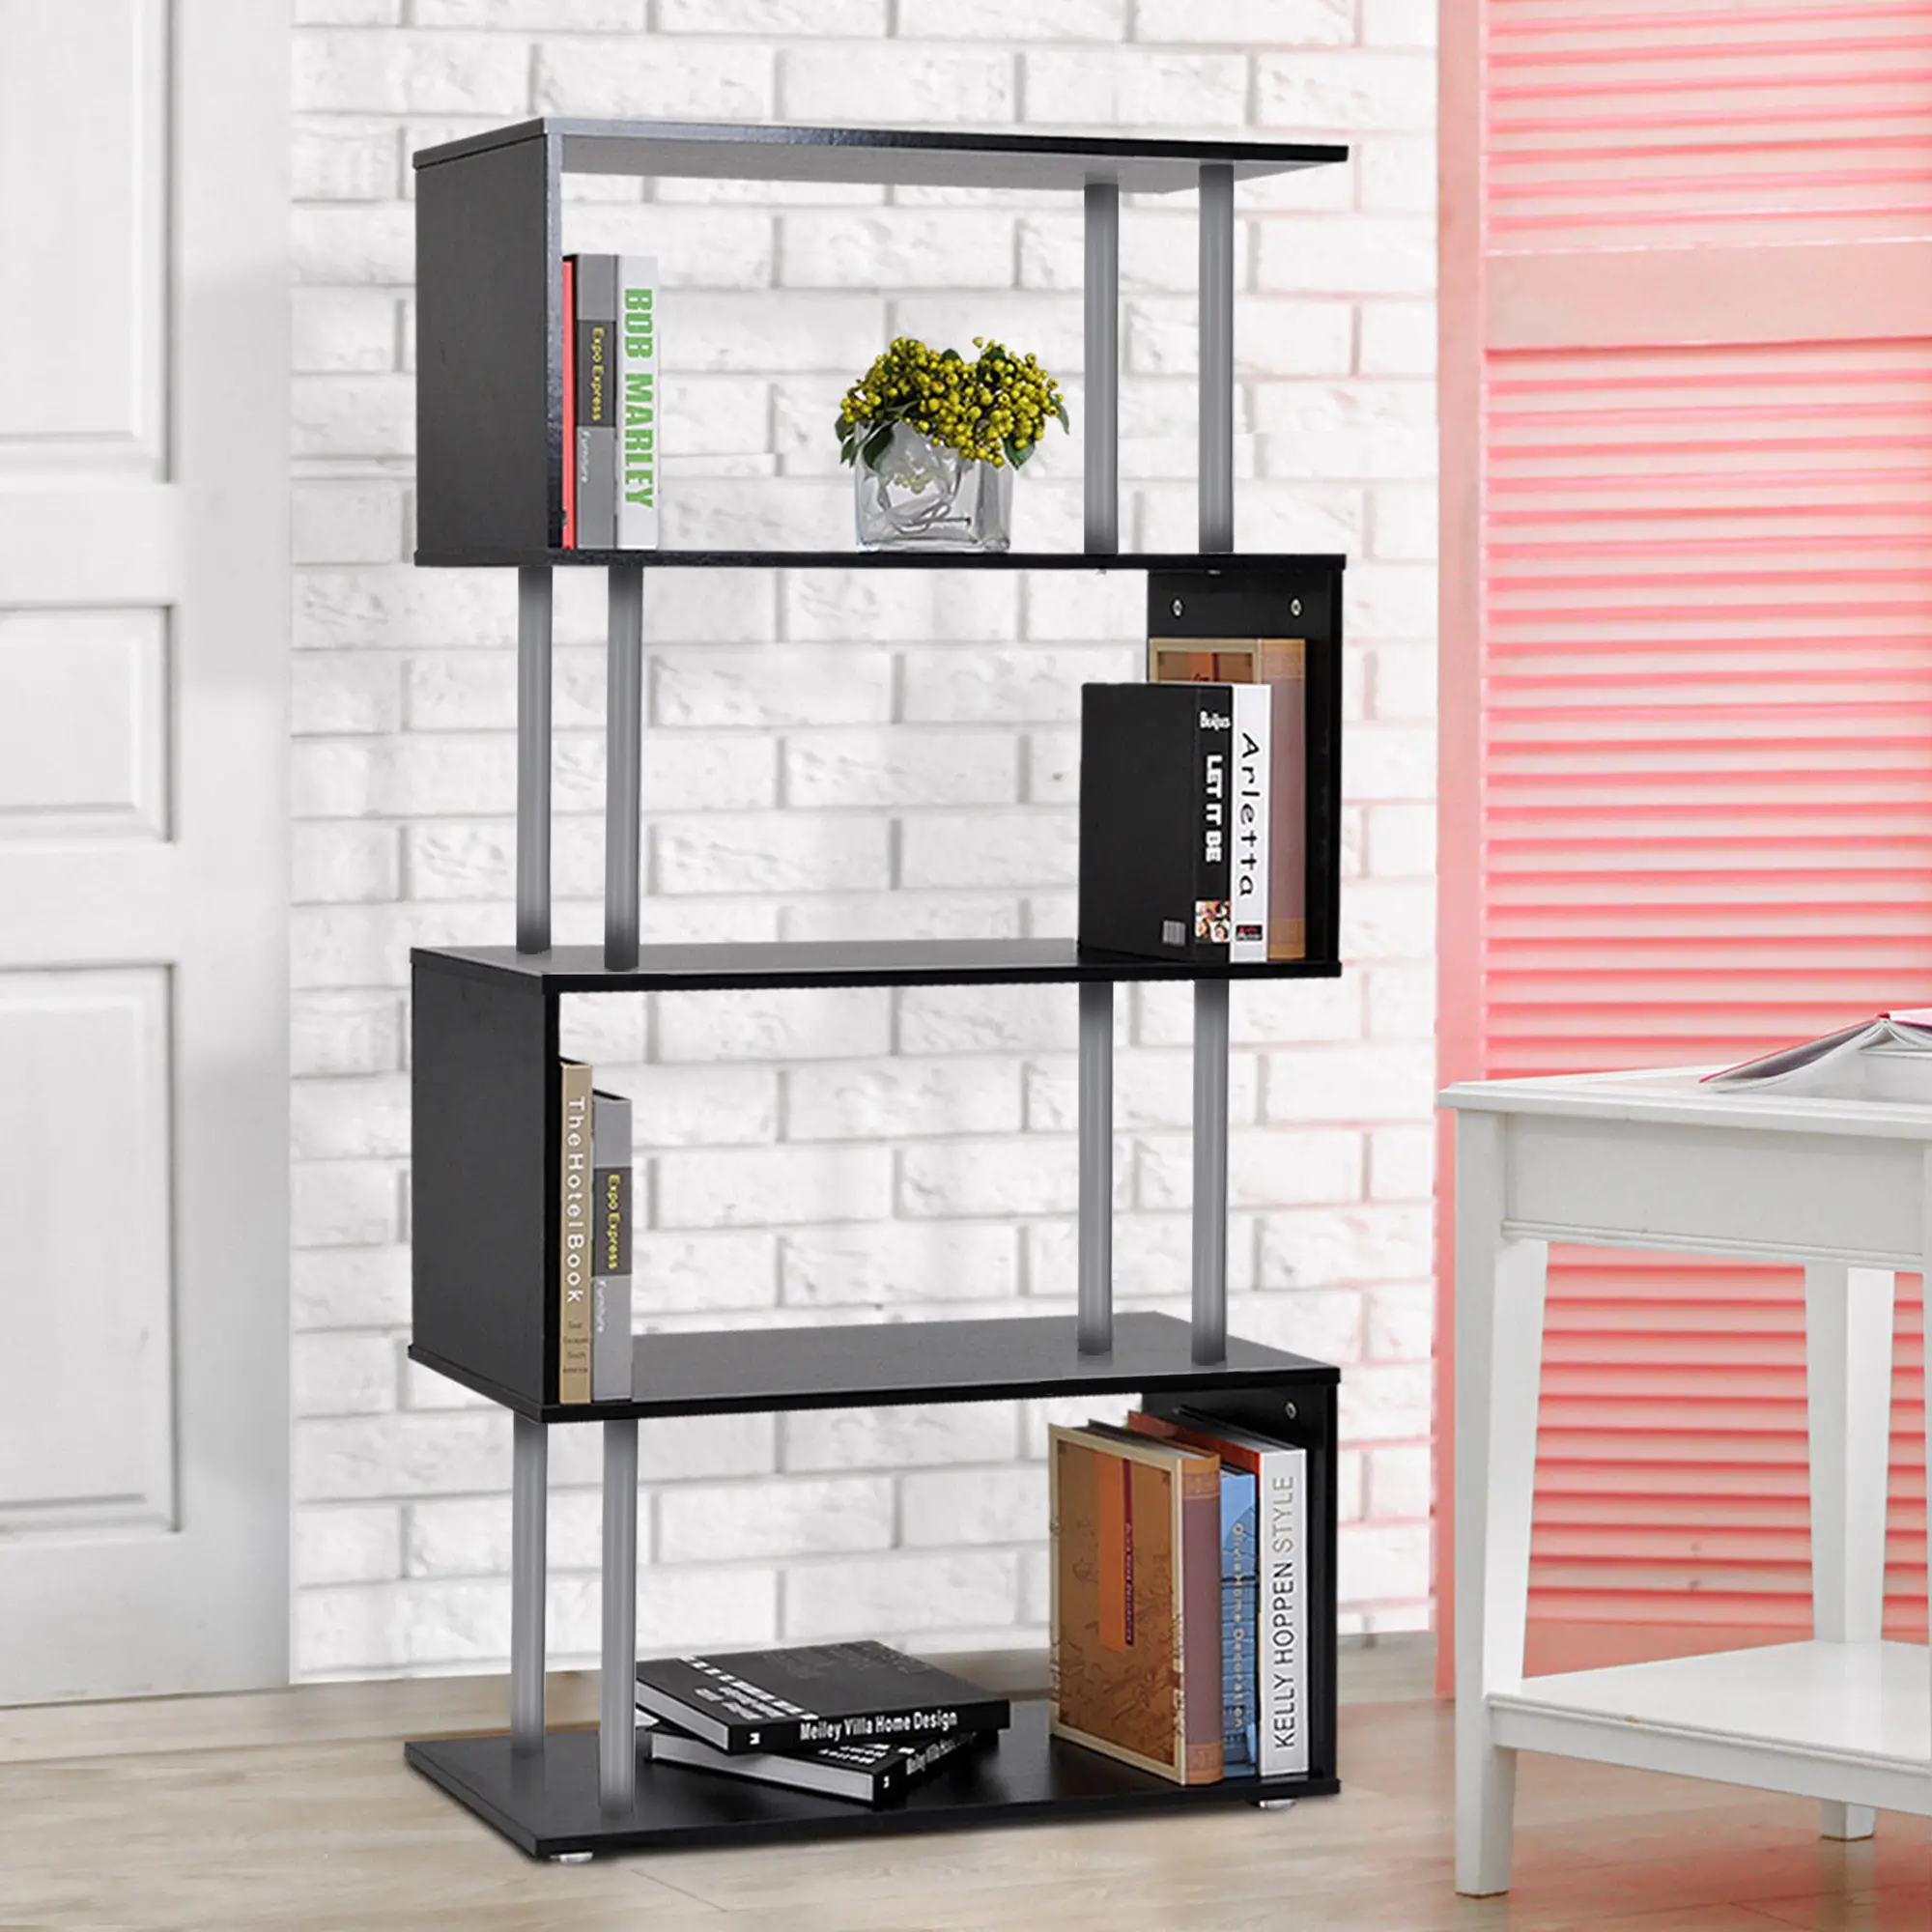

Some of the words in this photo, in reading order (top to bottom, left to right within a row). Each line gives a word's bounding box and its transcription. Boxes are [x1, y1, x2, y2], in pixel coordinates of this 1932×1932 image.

[590, 327, 605, 362] Expo
[625, 289, 654, 357] BOB
[590, 365, 605, 422] Express
[625, 374, 654, 508] MARLEY
[1206, 754, 1223, 798] LET
[1206, 803, 1223, 825] IT
[1239, 732, 1261, 896] Arletta
[1206, 831, 1222, 862] BE
[607, 1174, 621, 1210] Expo
[607, 1212, 621, 1270] Express
[1272, 1476, 1293, 1553] STYLE
[1273, 1561, 1294, 1664] HOPPEN
[875, 1714, 911, 1733] Home
[913, 1709, 958, 1731] Design
[1274, 1674, 1295, 1748] KELLY
